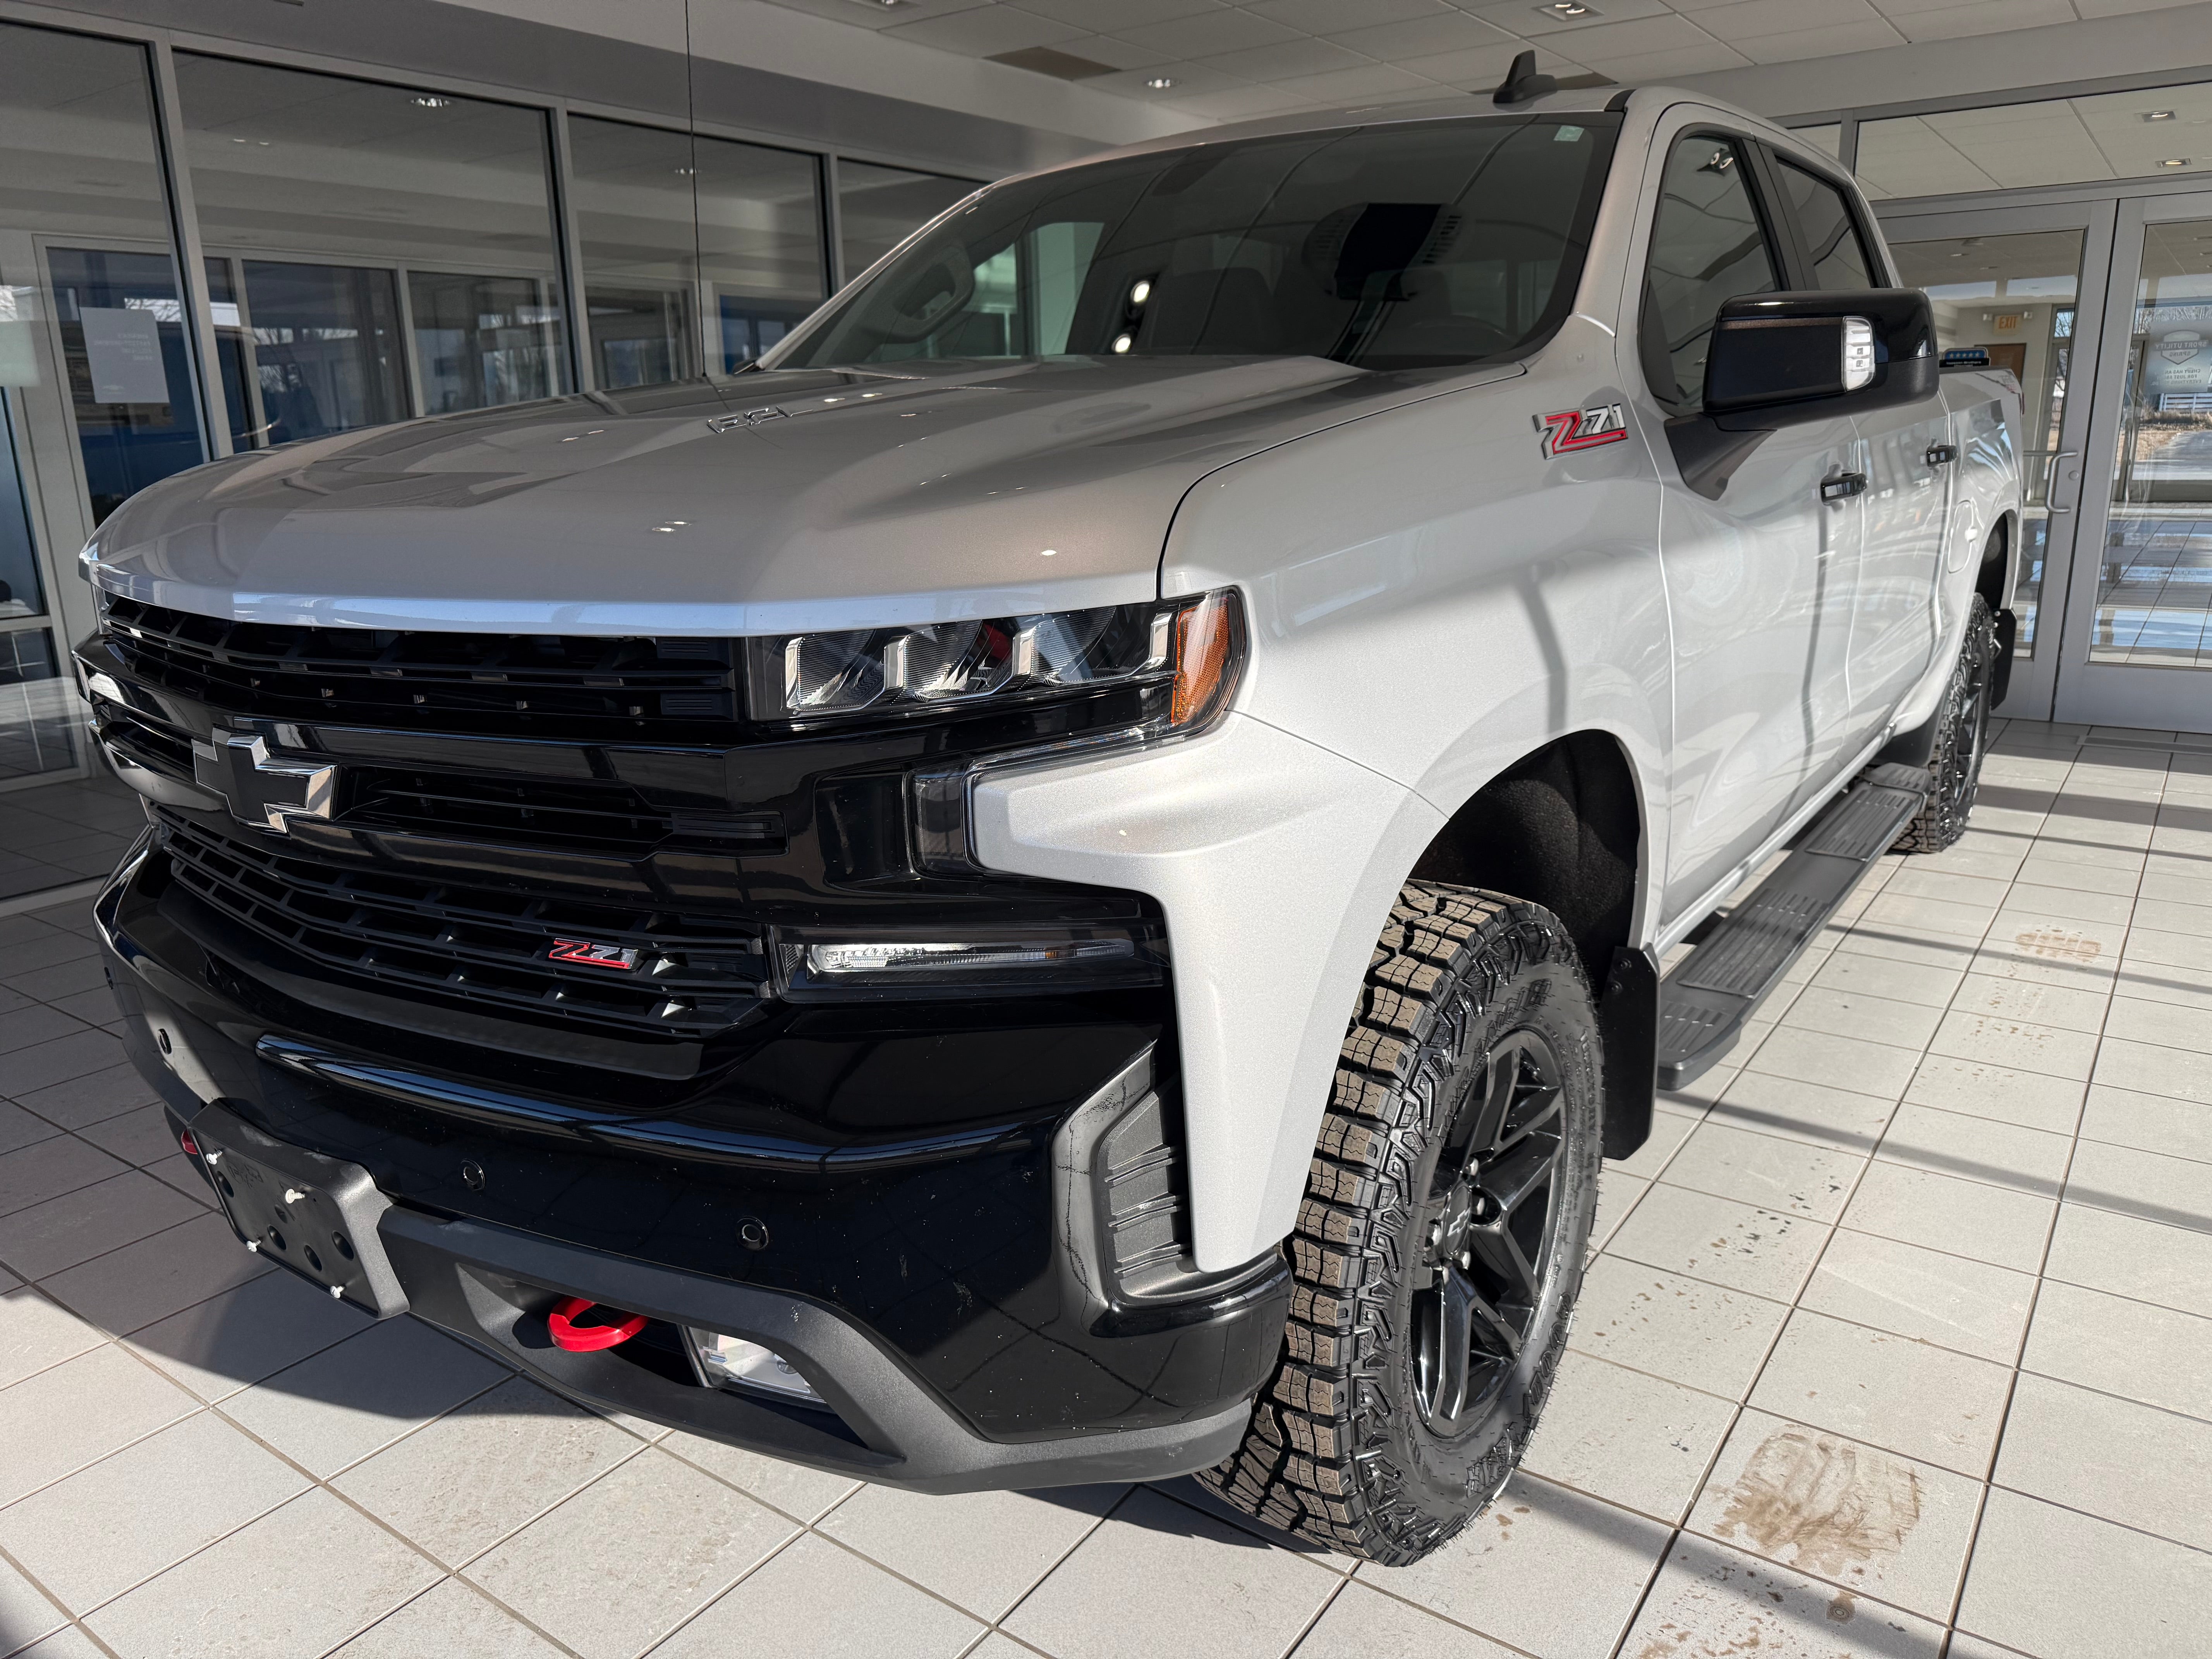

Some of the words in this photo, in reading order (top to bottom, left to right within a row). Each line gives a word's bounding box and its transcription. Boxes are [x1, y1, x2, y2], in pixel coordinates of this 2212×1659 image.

[1999, 316, 2017, 329] EXIT
[1532, 403, 1628, 460] Z71
[548, 938, 639, 969] Z71
